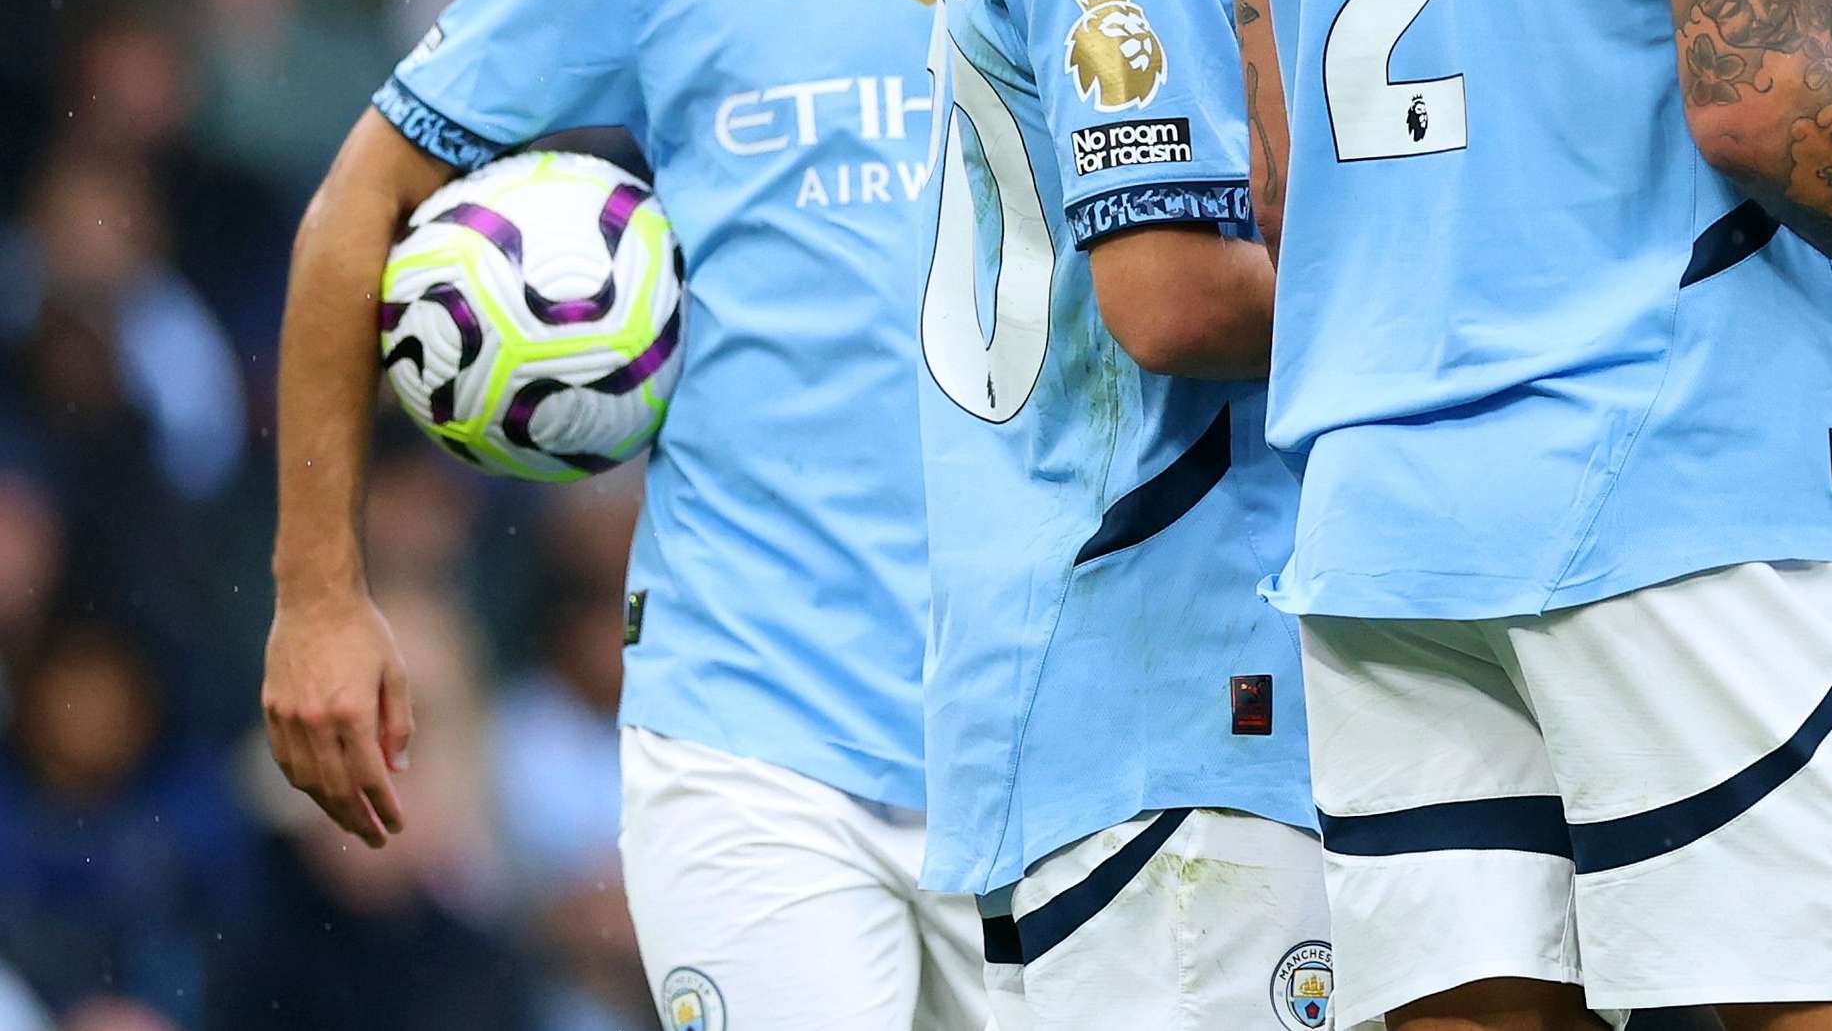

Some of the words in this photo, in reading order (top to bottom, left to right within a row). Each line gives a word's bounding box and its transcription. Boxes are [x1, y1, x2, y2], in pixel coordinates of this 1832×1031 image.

[1072, 129, 1106, 154] No
[1110, 123, 1178, 147] room
[1076, 150, 1107, 175] for
[1110, 143, 1191, 167] racism
[1279, 948, 1333, 981] MANCHES
